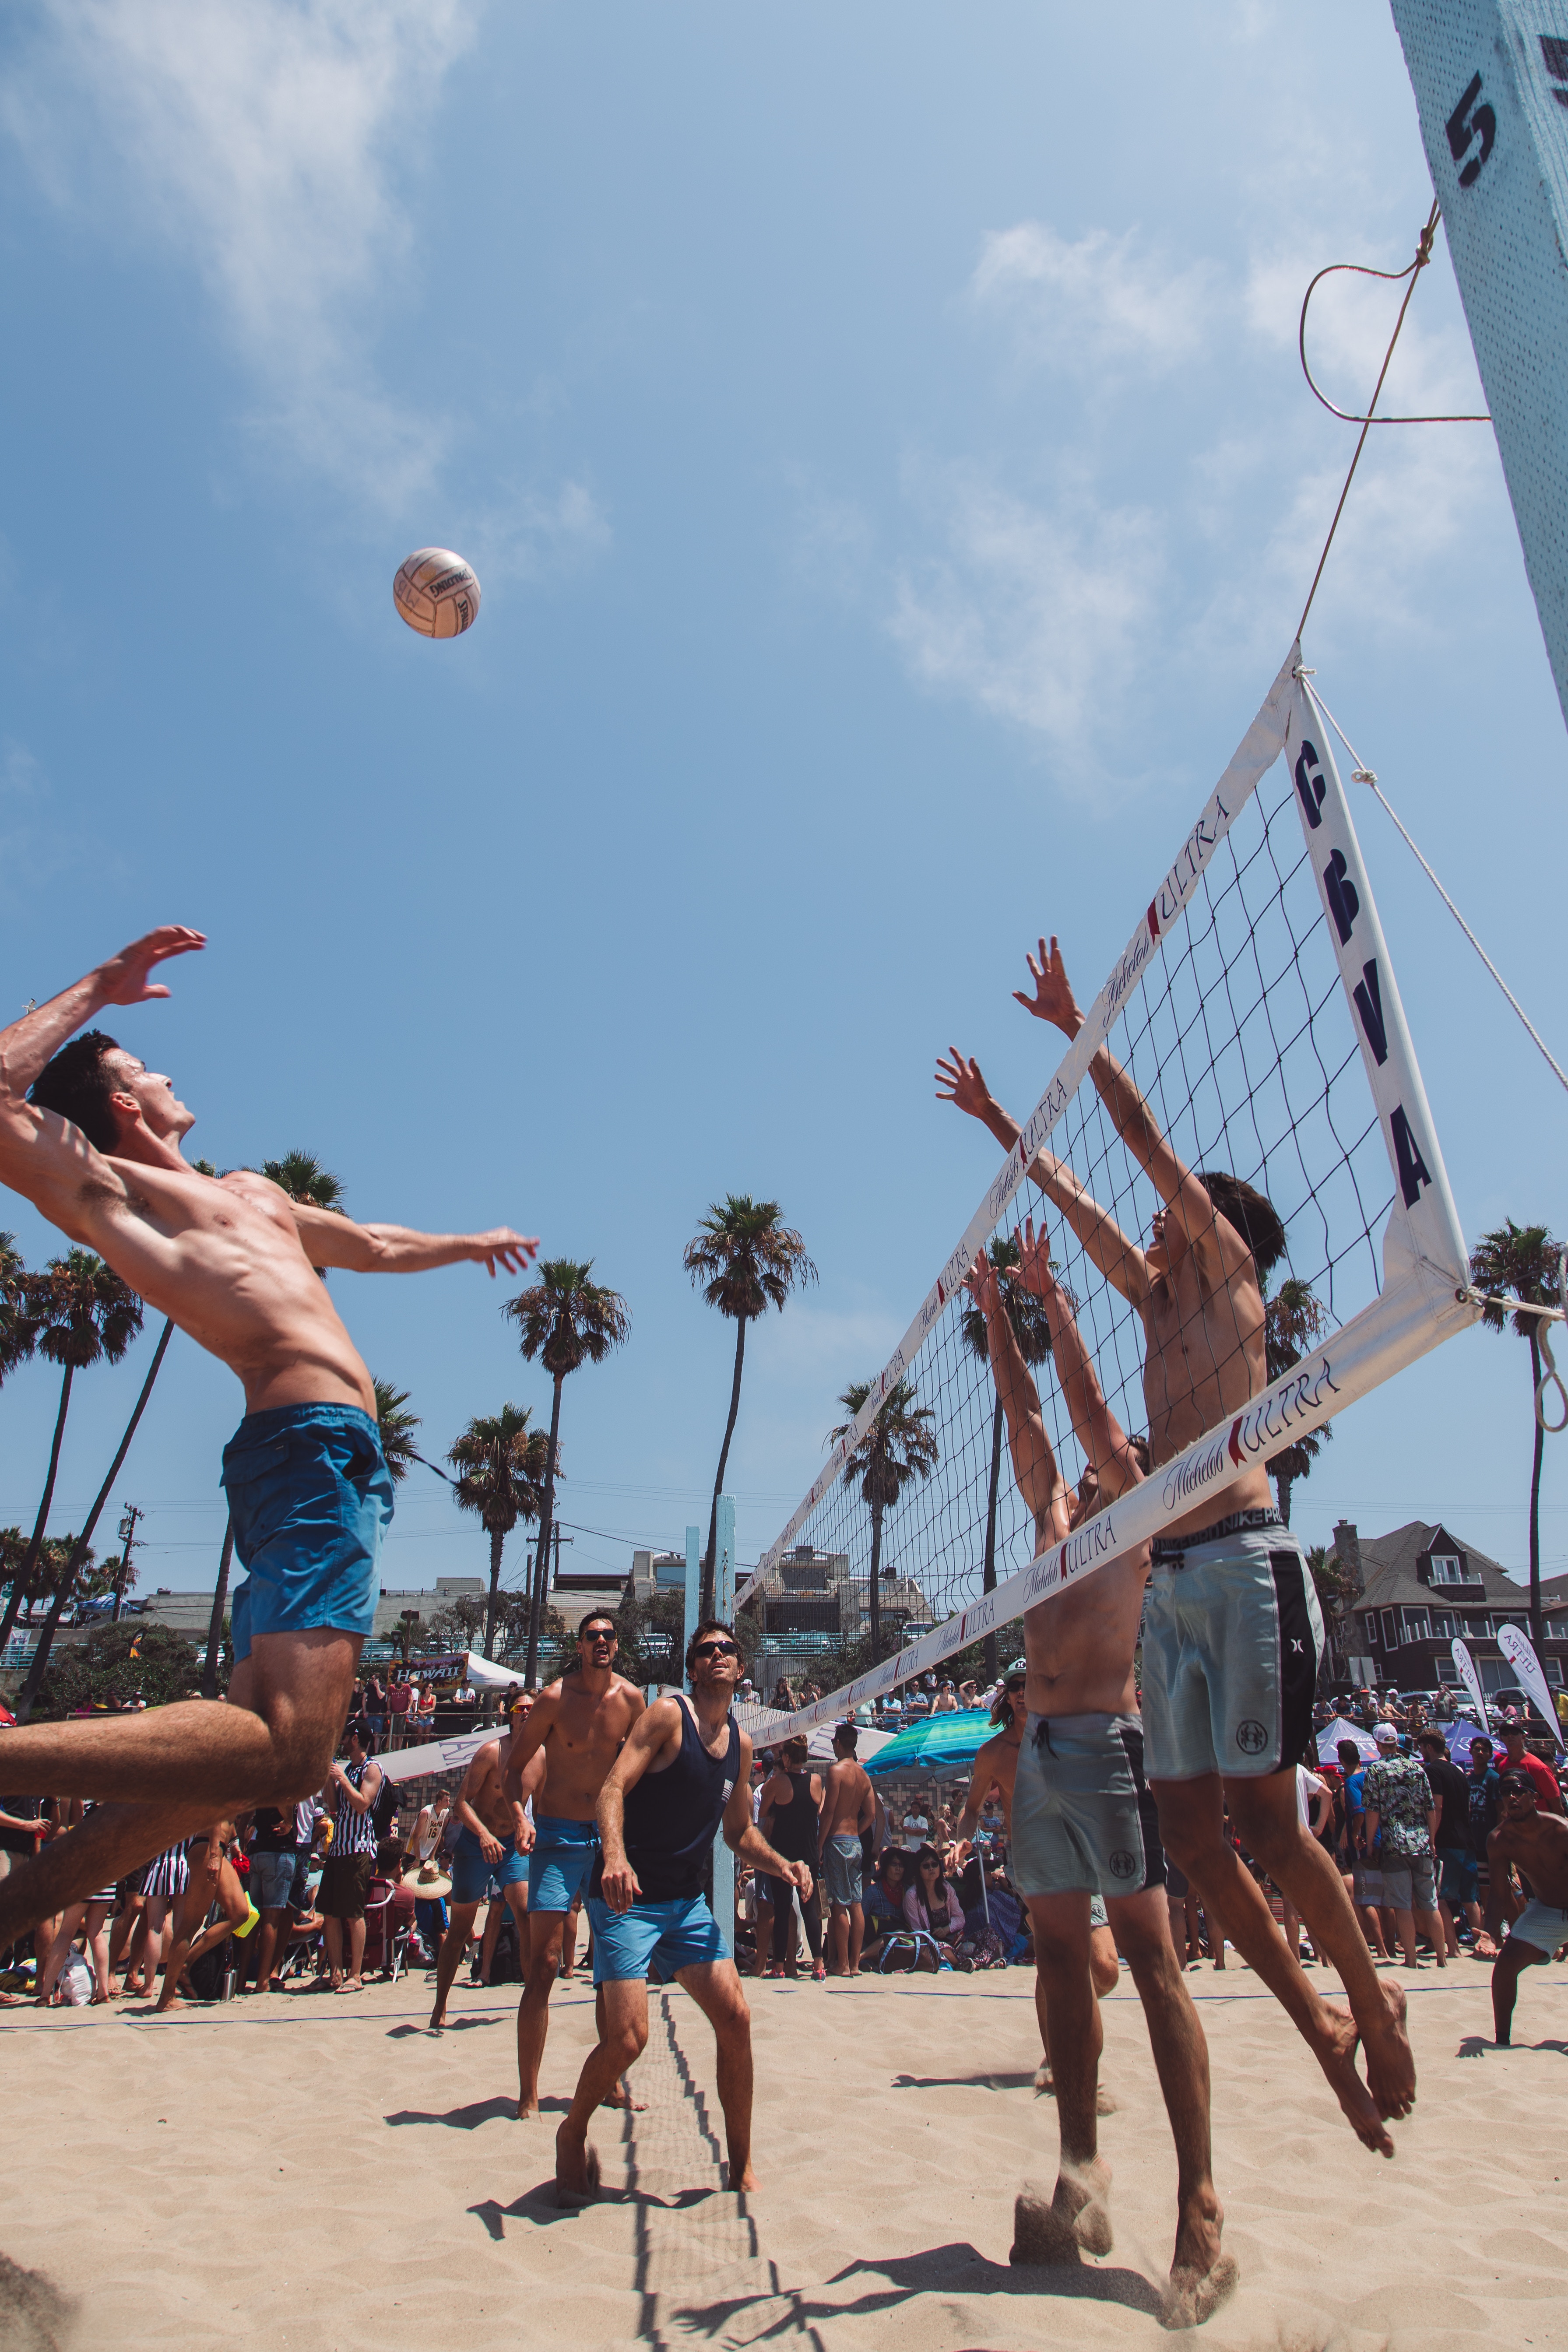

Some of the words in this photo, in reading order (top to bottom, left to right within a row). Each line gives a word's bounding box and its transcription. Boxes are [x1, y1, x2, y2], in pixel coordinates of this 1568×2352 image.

[1445, 70, 1496, 189] 5
[1101, 925, 1149, 1028] Michelob
[1162, 795, 1230, 920] ULTRA
[1024, 1077, 1067, 1155] ULTRA
[941, 1242, 970, 1296] ULTRA
[1163, 1437, 1226, 1510] Michelob
[1244, 1357, 1340, 1452] ULTRA
[1223, 1509, 1263, 1535] NIKE
[1023, 1556, 1058, 1603] Michelob
[1069, 1514, 1117, 1573] ULTRA
[966, 1597, 995, 1639] ULTRA
[397, 1666, 459, 1682] HAWAII
[898, 1647, 919, 1678] ULTRA
[428, 1828, 438, 1839] 16
